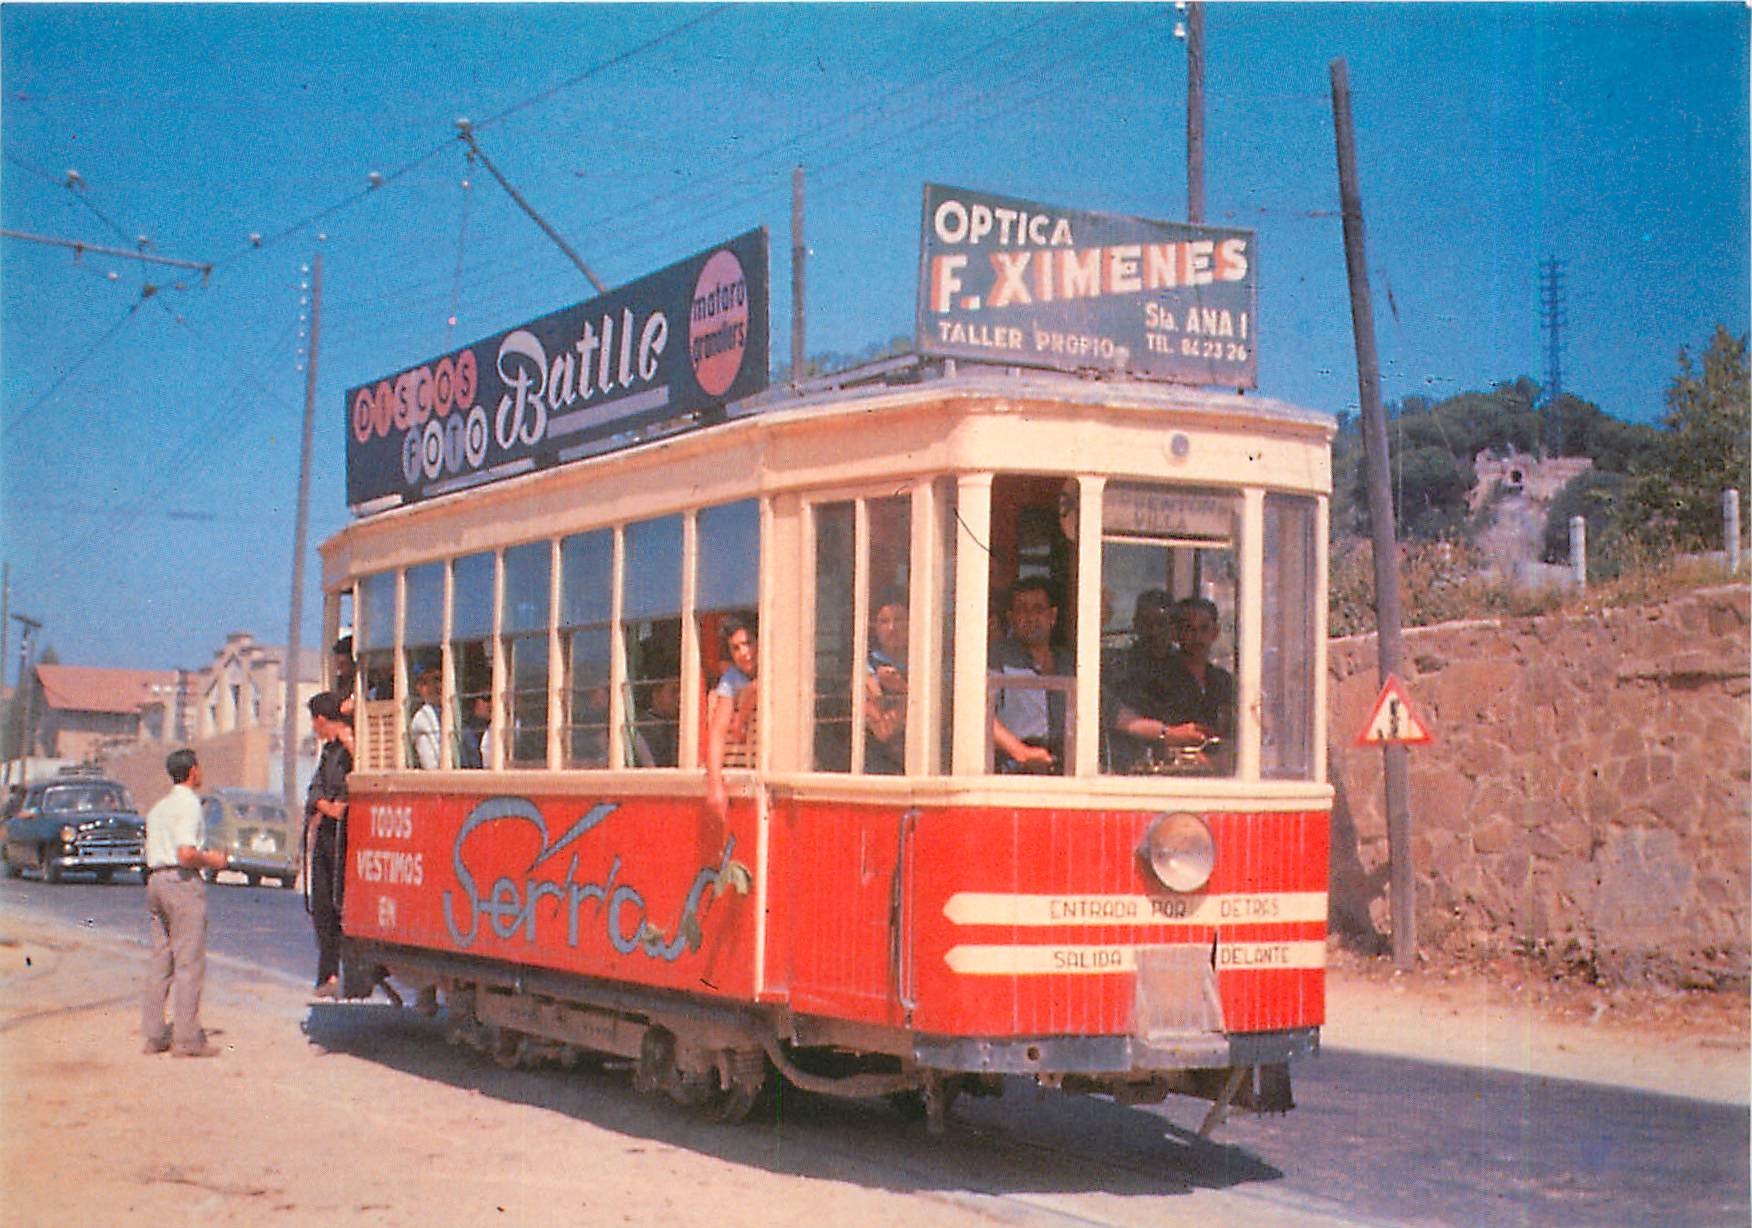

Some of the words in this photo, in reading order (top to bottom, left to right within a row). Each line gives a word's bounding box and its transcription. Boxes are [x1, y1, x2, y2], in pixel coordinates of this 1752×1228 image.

[934, 200, 1073, 246] OPTICA
[986, 238, 1248, 307] XIMENES
[938, 321, 1022, 349] TALLER
[1034, 328, 1114, 359] PROPIO
[1186, 307, 1233, 337] ANA
[355, 354, 475, 439] DISCOS
[495, 307, 668, 450] Batlle
[404, 408, 486, 481] FOTO
[370, 806, 413, 839] TODOS
[357, 849, 424, 887] VESTIMOS
[1050, 899, 1137, 920] ENTRADA
[1151, 899, 1187, 919] POR
[1220, 896, 1280, 917] DETRAS
[1053, 950, 1122, 969] SALIDA
[1220, 945, 1290, 966] DELANTE
